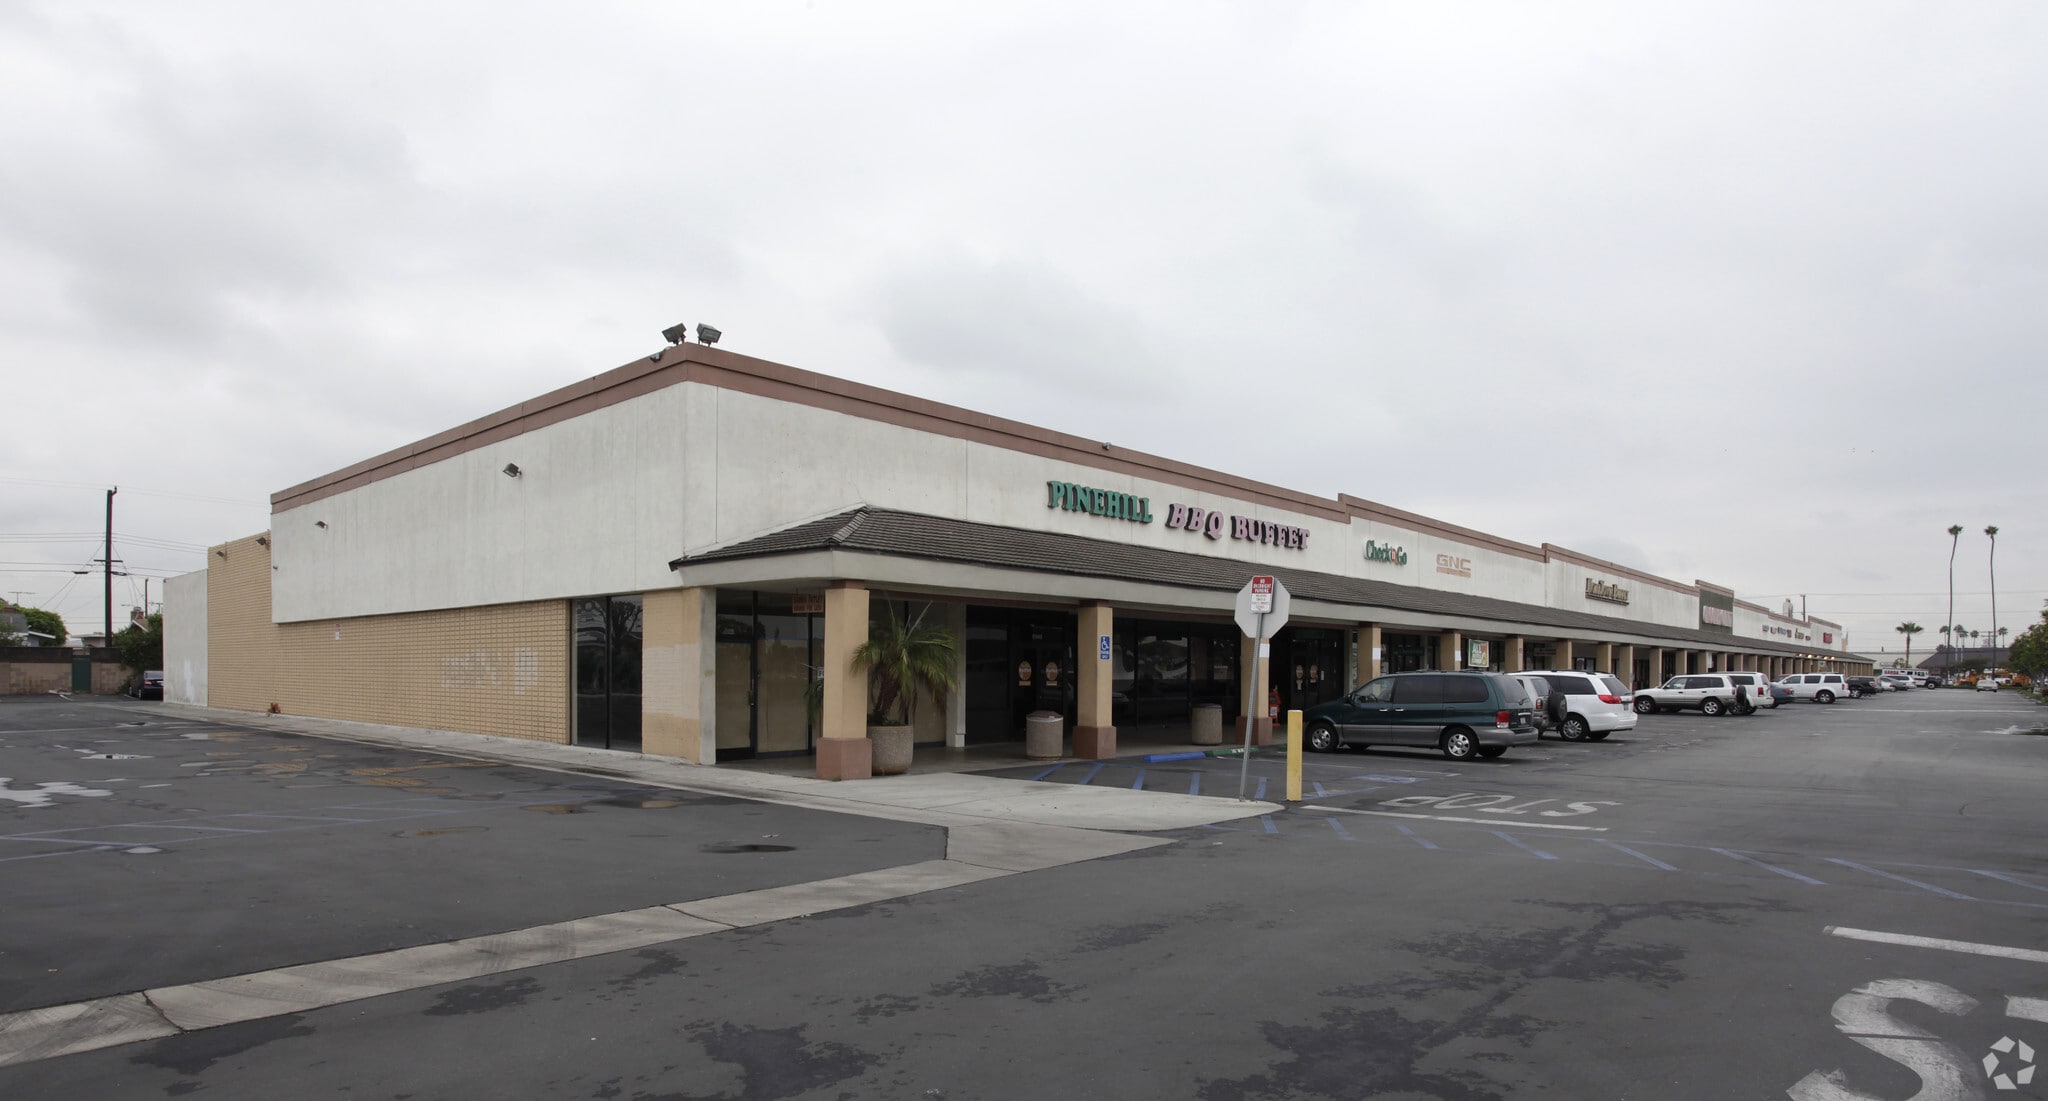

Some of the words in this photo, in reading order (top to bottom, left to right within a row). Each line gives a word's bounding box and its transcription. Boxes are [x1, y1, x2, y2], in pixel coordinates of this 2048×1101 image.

[1047, 481, 1153, 523] PINEHILL
[1166, 503, 1224, 540] BBQ
[1230, 515, 1310, 549] BUFFET
[1365, 539, 1391, 562] Check
[1397, 546, 1407, 566] Go
[1436, 554, 1471, 571] GNC
[1377, 793, 1622, 817] STOP
